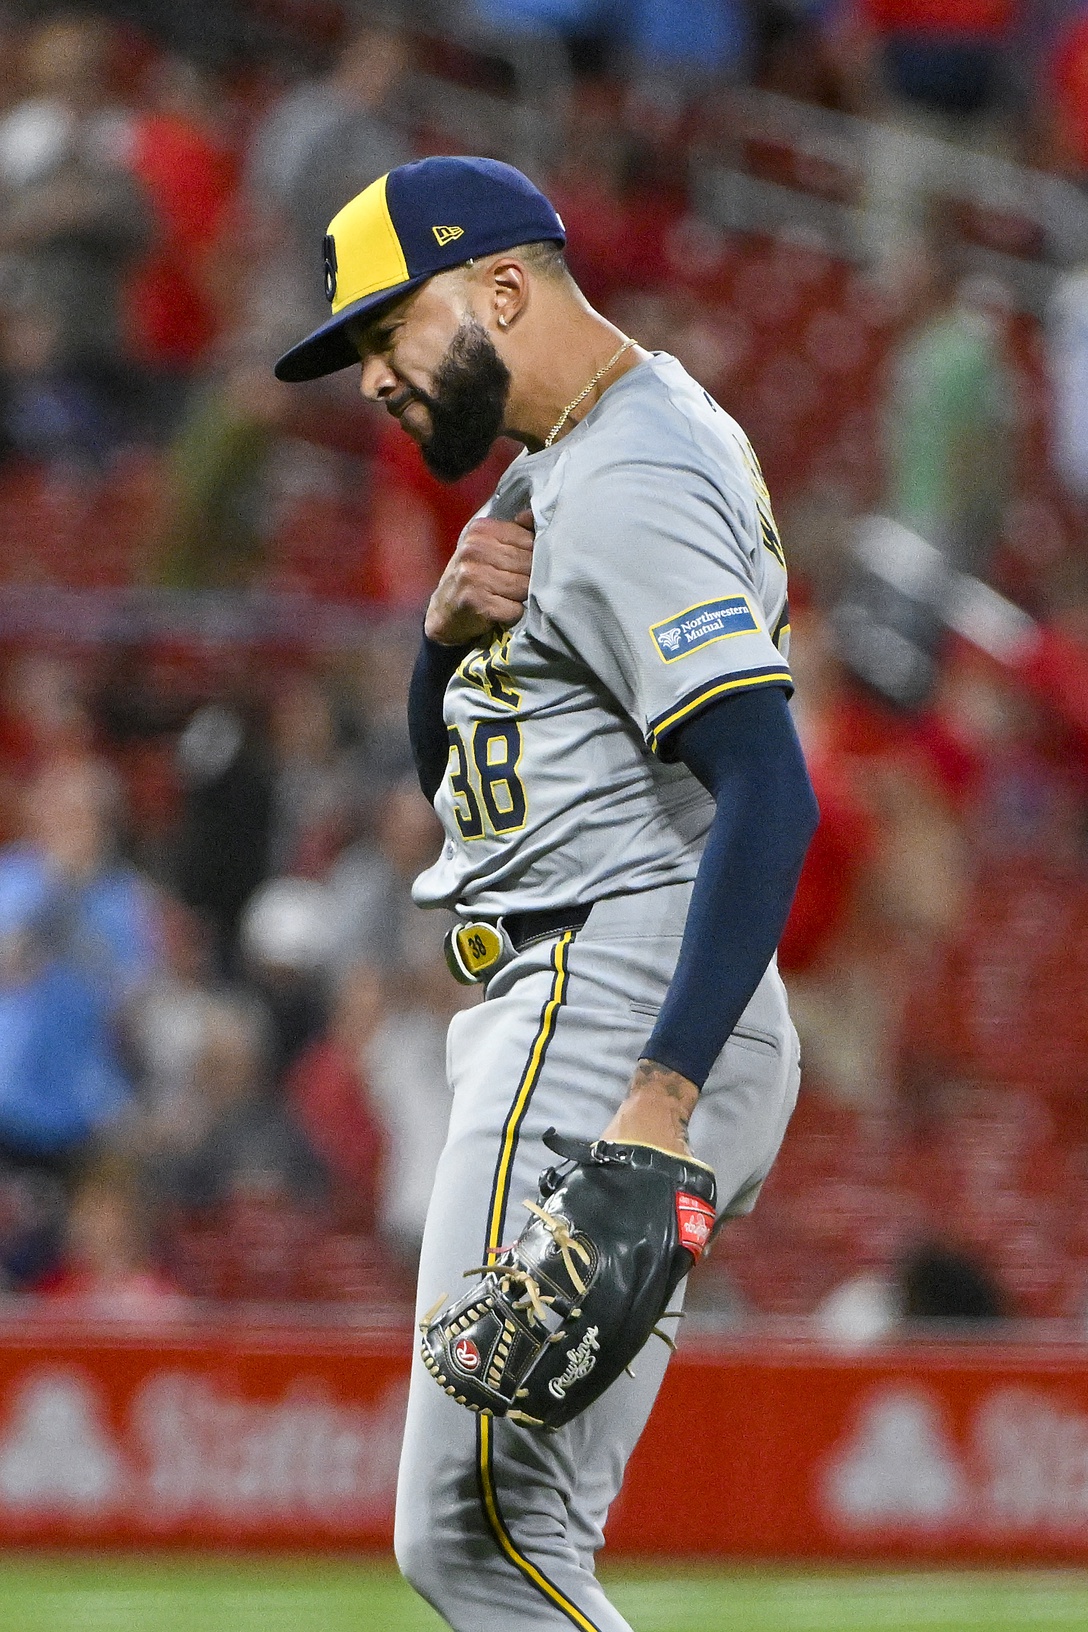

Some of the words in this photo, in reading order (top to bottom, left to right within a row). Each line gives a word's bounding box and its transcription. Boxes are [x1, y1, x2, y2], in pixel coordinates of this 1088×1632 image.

[680, 606, 750, 633] Northwestern
[684, 619, 725, 643] Mutual
[447, 720, 528, 842] 38
[468, 934, 487, 959] 38
[548, 1325, 601, 1400] Rawlings
